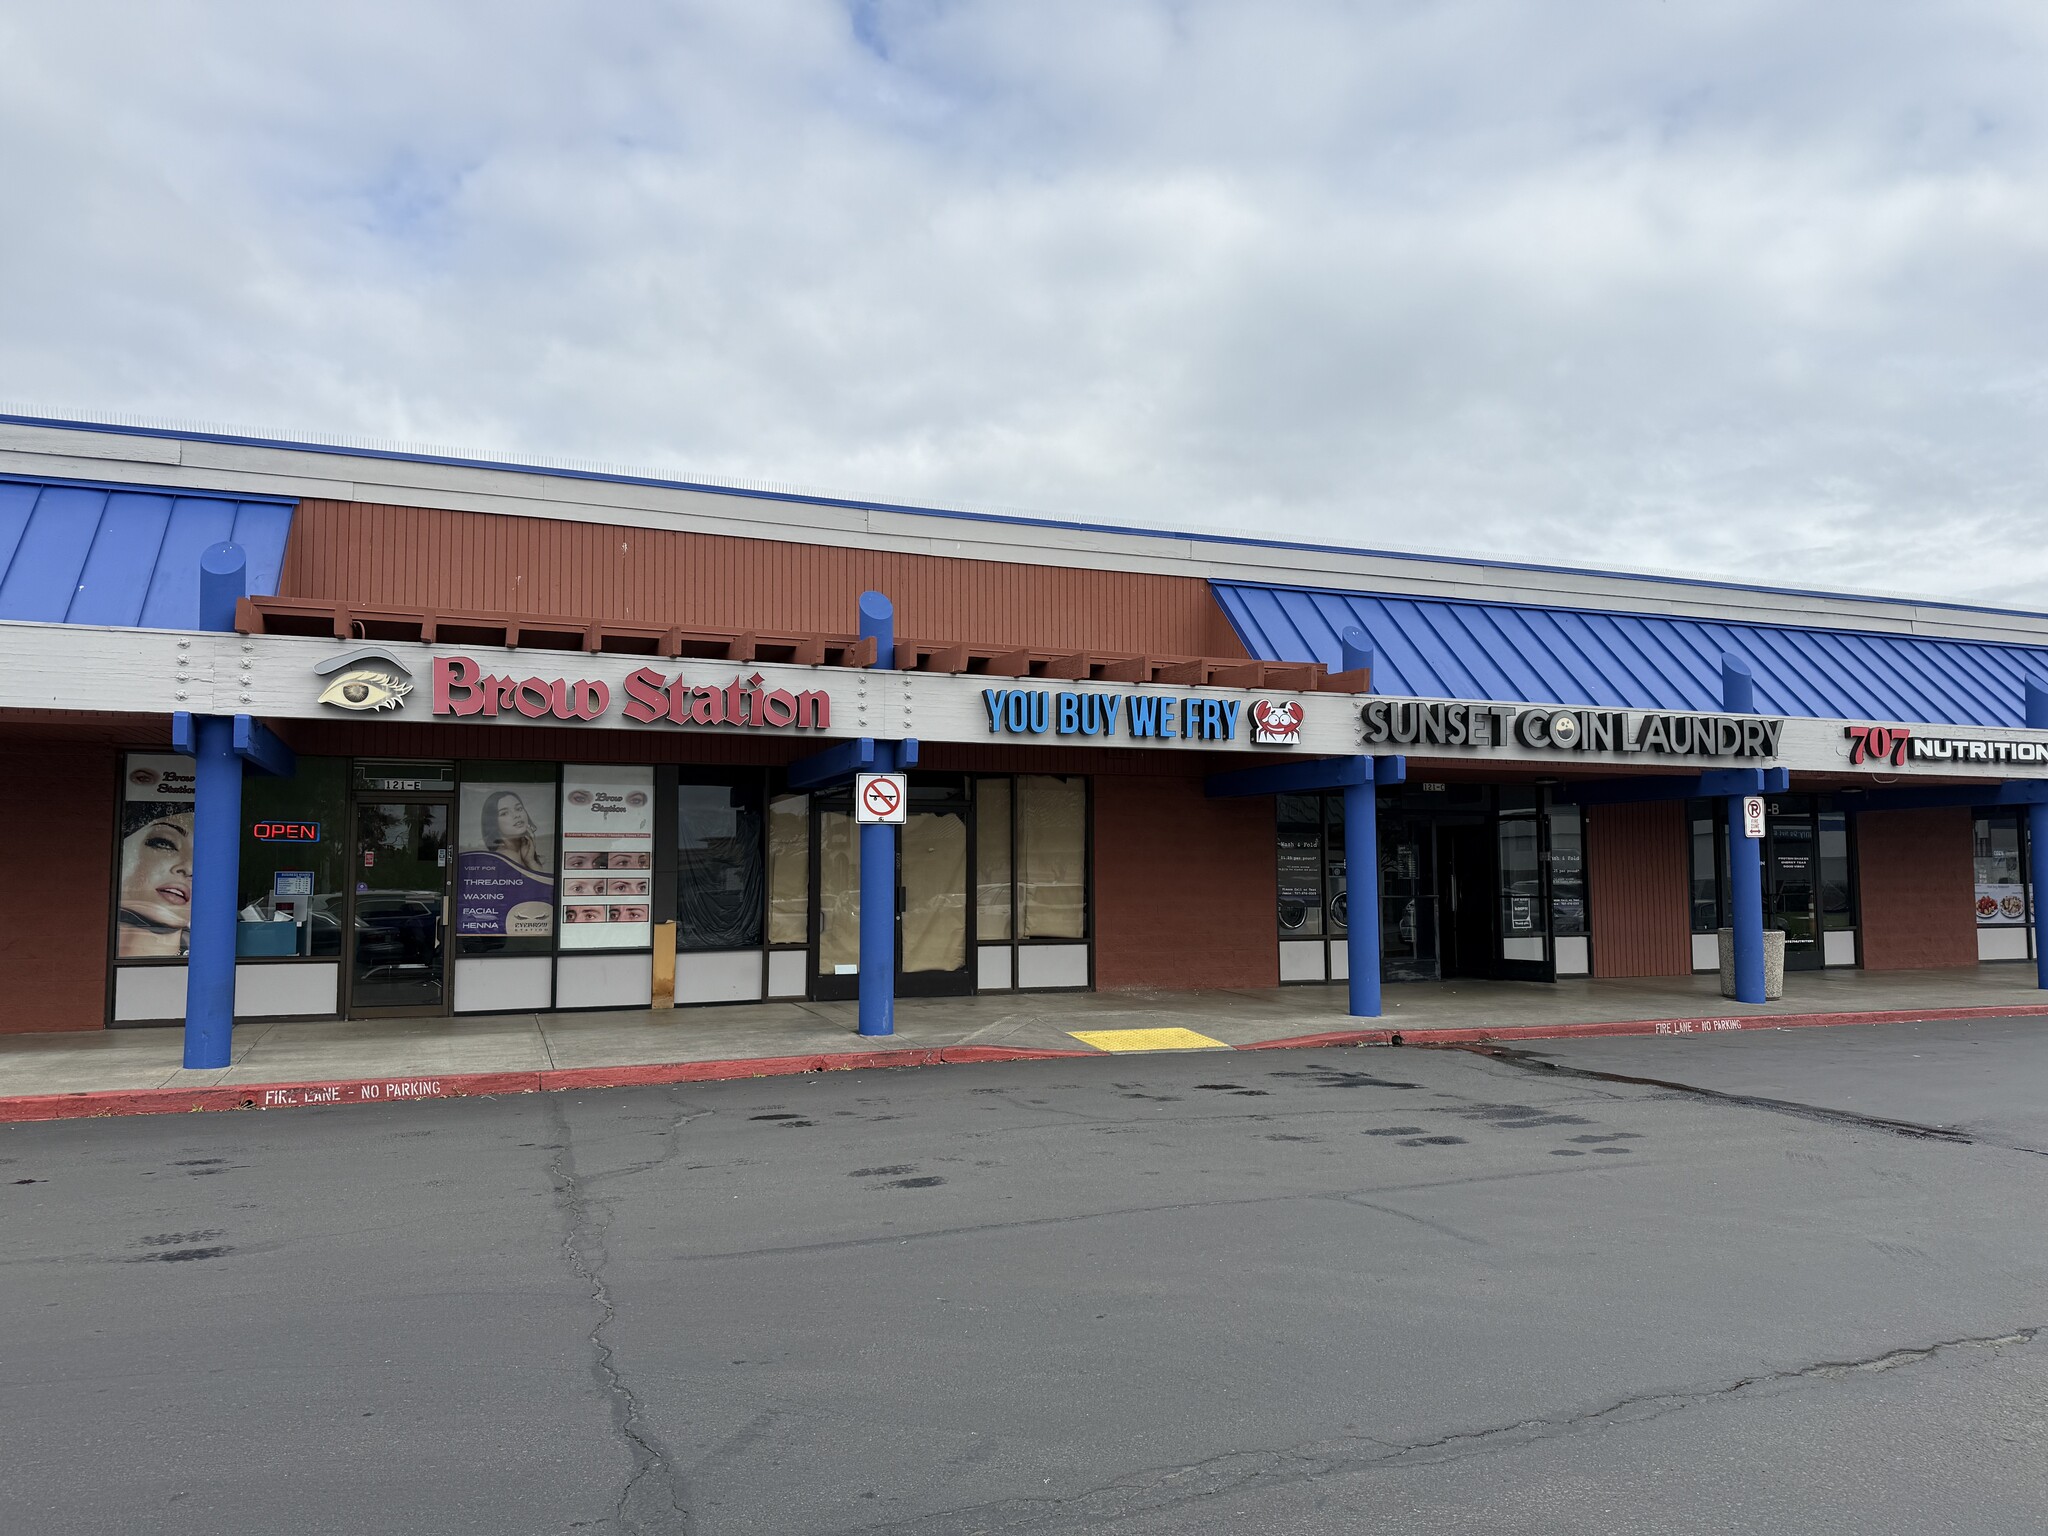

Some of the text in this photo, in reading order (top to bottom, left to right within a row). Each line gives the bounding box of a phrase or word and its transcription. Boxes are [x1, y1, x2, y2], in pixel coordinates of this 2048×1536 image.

[432, 656, 831, 728] Brow Station
[982, 689, 1241, 740] YOU BUY WE FRY
[1361, 700, 1784, 757] SUNSET COIN LAUNDRY
[1845, 726, 2048, 766] 707 NUTRITION
[385, 781, 421, 790] 121-E
[595, 792, 623, 802] Brow
[591, 803, 627, 813] Station
[253, 824, 315, 840] OPEN
[1655, 1023, 1672, 1034] FIRE
[1674, 1022, 1692, 1034] LANE
[1702, 1021, 1712, 1031] NO
[1714, 1020, 1742, 1030] PARKING
[361, 1085, 380, 1099] NO
[386, 1081, 440, 1098] PARKING
